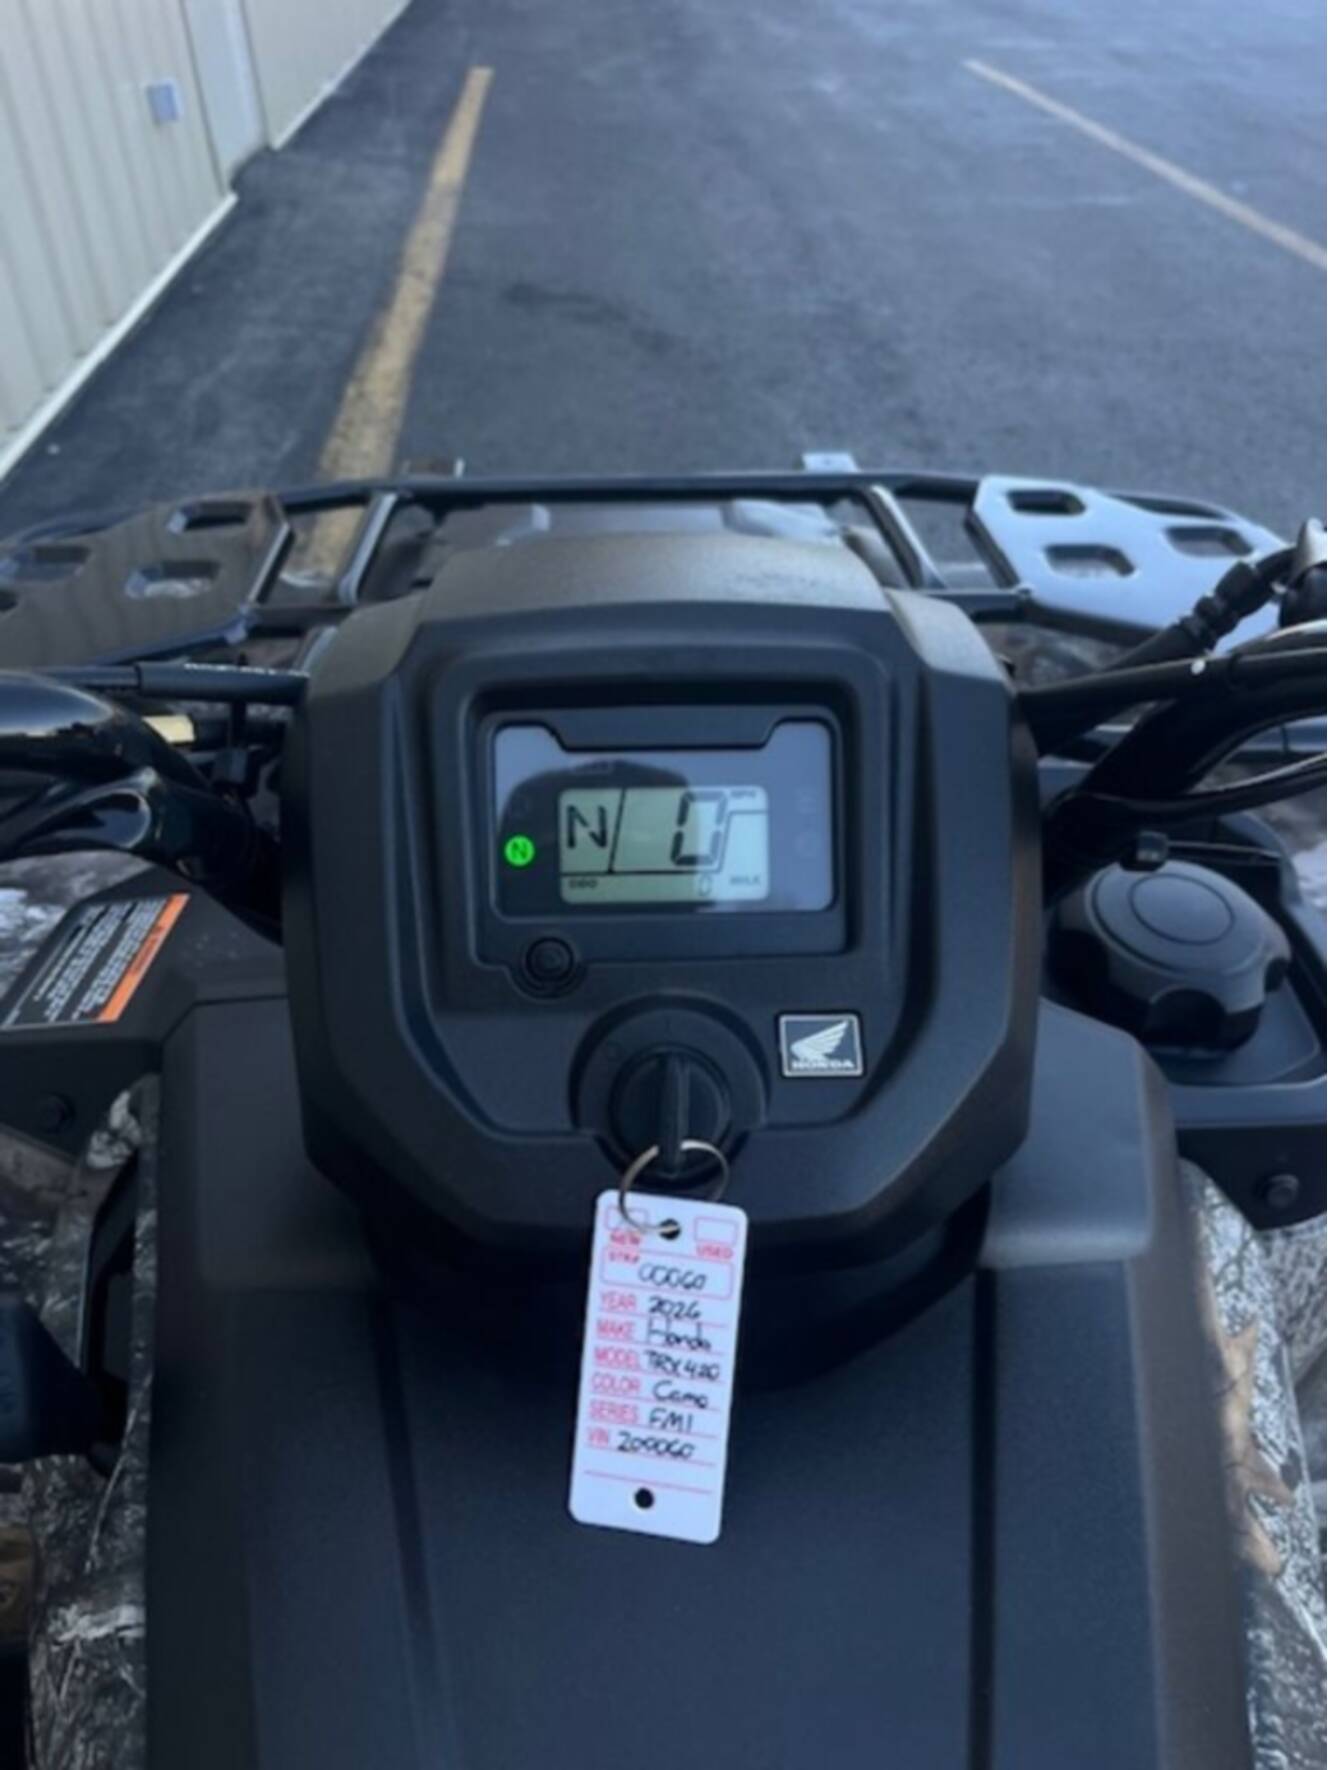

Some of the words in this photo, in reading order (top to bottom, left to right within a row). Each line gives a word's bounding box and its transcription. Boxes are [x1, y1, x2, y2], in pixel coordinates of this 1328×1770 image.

[566, 805, 609, 849] N
[671, 791, 727, 866] 0
[510, 844, 527, 859] N
[696, 1244, 733, 1261] USED
[600, 1292, 637, 1311] YEAR
[597, 1319, 636, 1341] MAKE
[647, 1318, 711, 1351] Honda
[594, 1347, 641, 1370] MODEL
[591, 1374, 640, 1395] COLOR
[652, 1381, 709, 1410] Camo
[589, 1400, 638, 1424] SERIES
[588, 1427, 609, 1447] VIN
